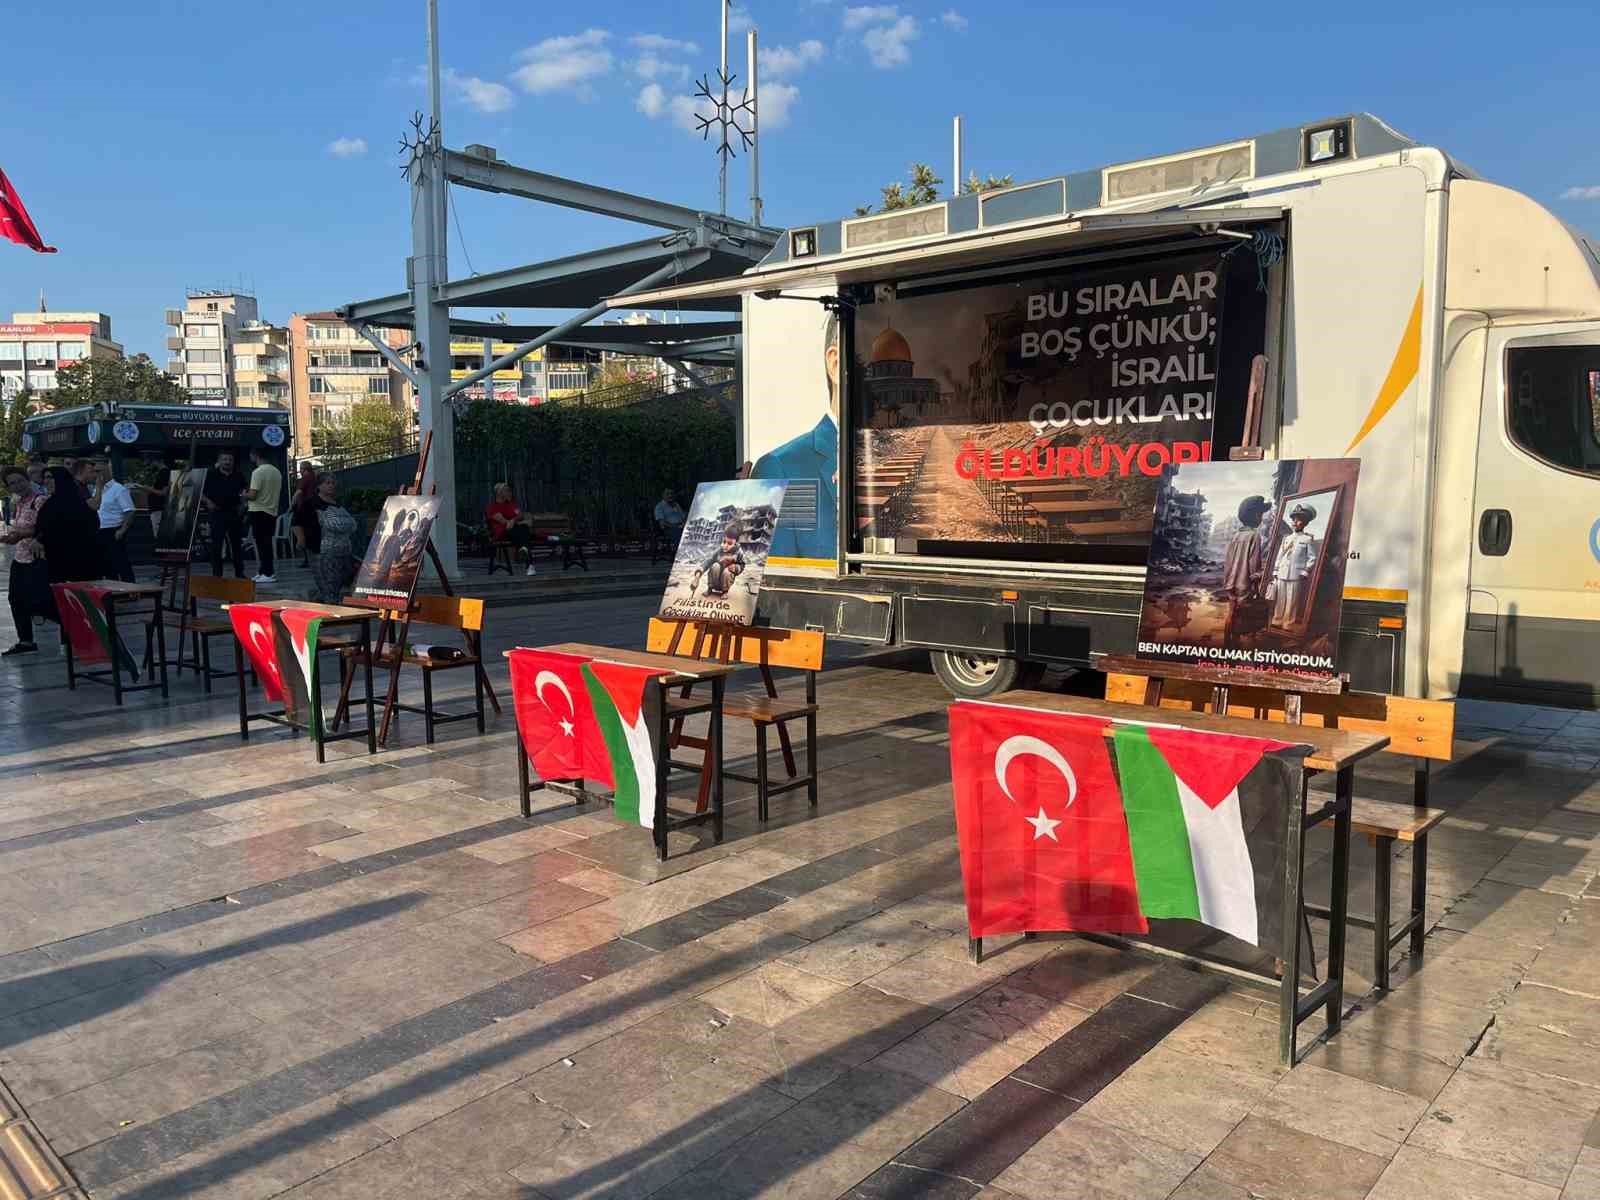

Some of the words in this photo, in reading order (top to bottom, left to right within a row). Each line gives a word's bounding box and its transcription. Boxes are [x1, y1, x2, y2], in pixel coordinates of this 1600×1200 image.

[1027, 290, 1069, 321] BU
[1076, 270, 1217, 316] SIRALAR
[1020, 327, 1082, 361] BOŞ
[1088, 305, 1217, 359] ÇÜNKÜ;
[1111, 345, 1215, 387] İSRAİL
[1028, 391, 1213, 436] ÇOCUKLARI
[1138, 642, 1161, 653] BEN
[1162, 643, 1208, 657] KAPTAN
[1209, 648, 1252, 662] OLMAK
[1253, 648, 1334, 669] İSTİYORDUM.
